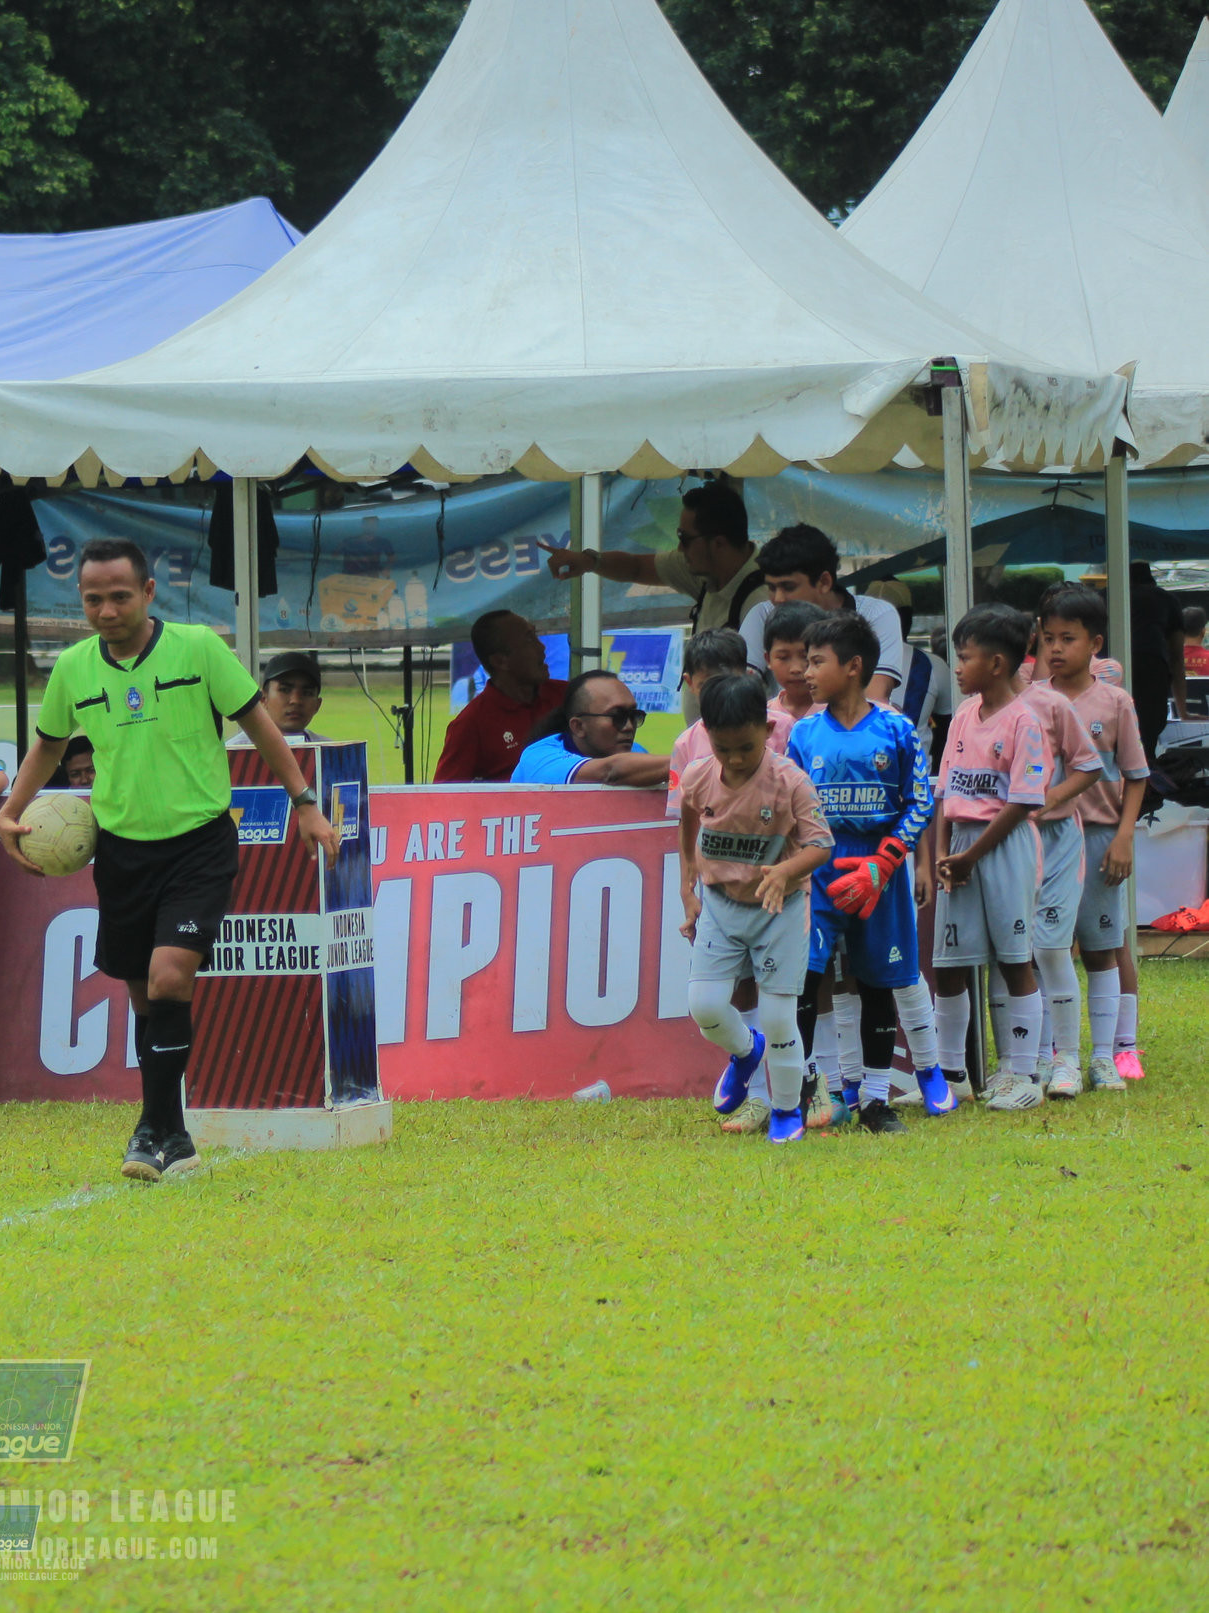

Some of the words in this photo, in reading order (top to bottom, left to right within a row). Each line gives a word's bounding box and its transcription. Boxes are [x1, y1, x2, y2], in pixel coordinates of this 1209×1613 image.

[818, 788, 852, 804] SSB
[854, 787, 887, 803] NAZ
[237, 828, 280, 842] eague
[403, 820, 466, 863] ARE
[481, 814, 542, 857] THE
[701, 832, 734, 850] SSB
[333, 912, 366, 940] INDONESIA
[945, 923, 958, 947] 21
[255, 945, 320, 971] LEAGUE
[327, 942, 349, 968] JUNIOR
[351, 938, 374, 965] LEAGUE
